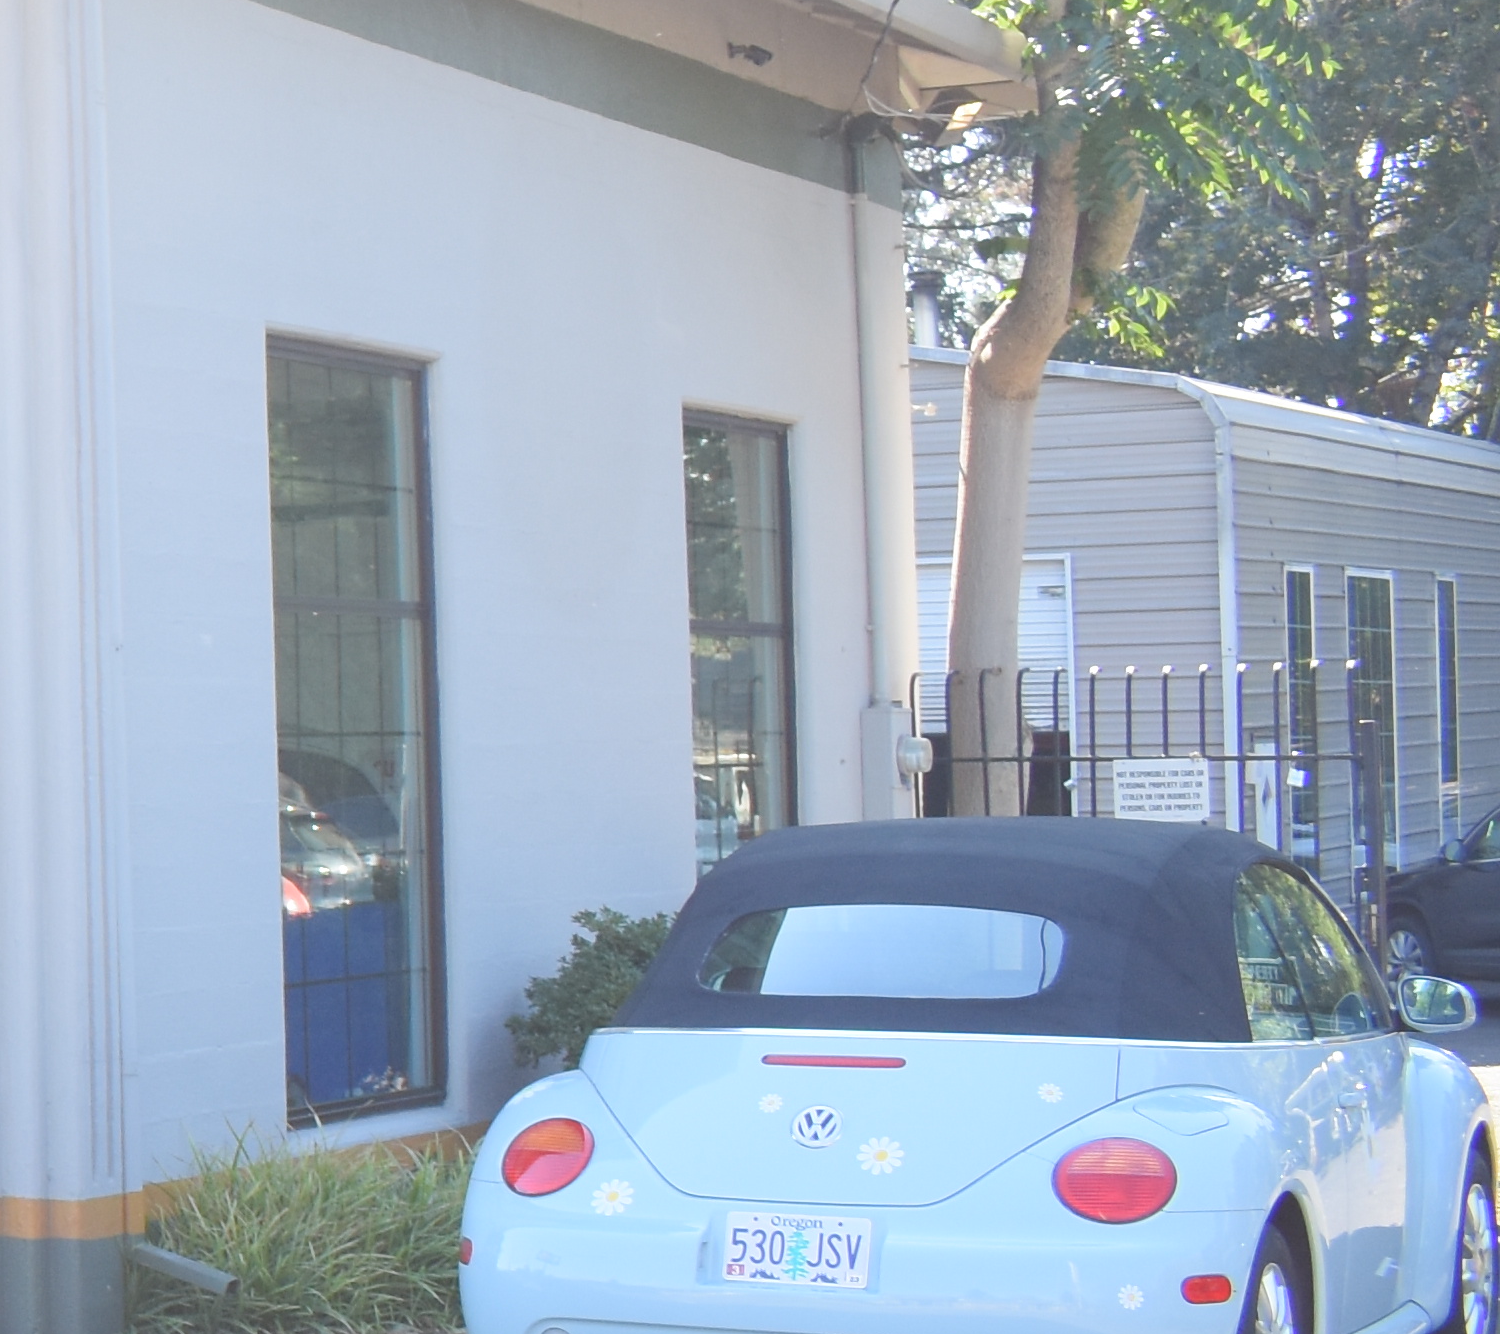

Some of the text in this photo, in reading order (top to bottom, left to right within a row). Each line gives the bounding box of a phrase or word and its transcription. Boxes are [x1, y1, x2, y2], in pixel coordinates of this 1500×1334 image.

[1148, 781, 1177, 789] PROPERTY
[1174, 803, 1203, 811] PROPERTY
[771, 1215, 824, 1230] Oregon
[730, 1227, 862, 1270] 530 JSV
